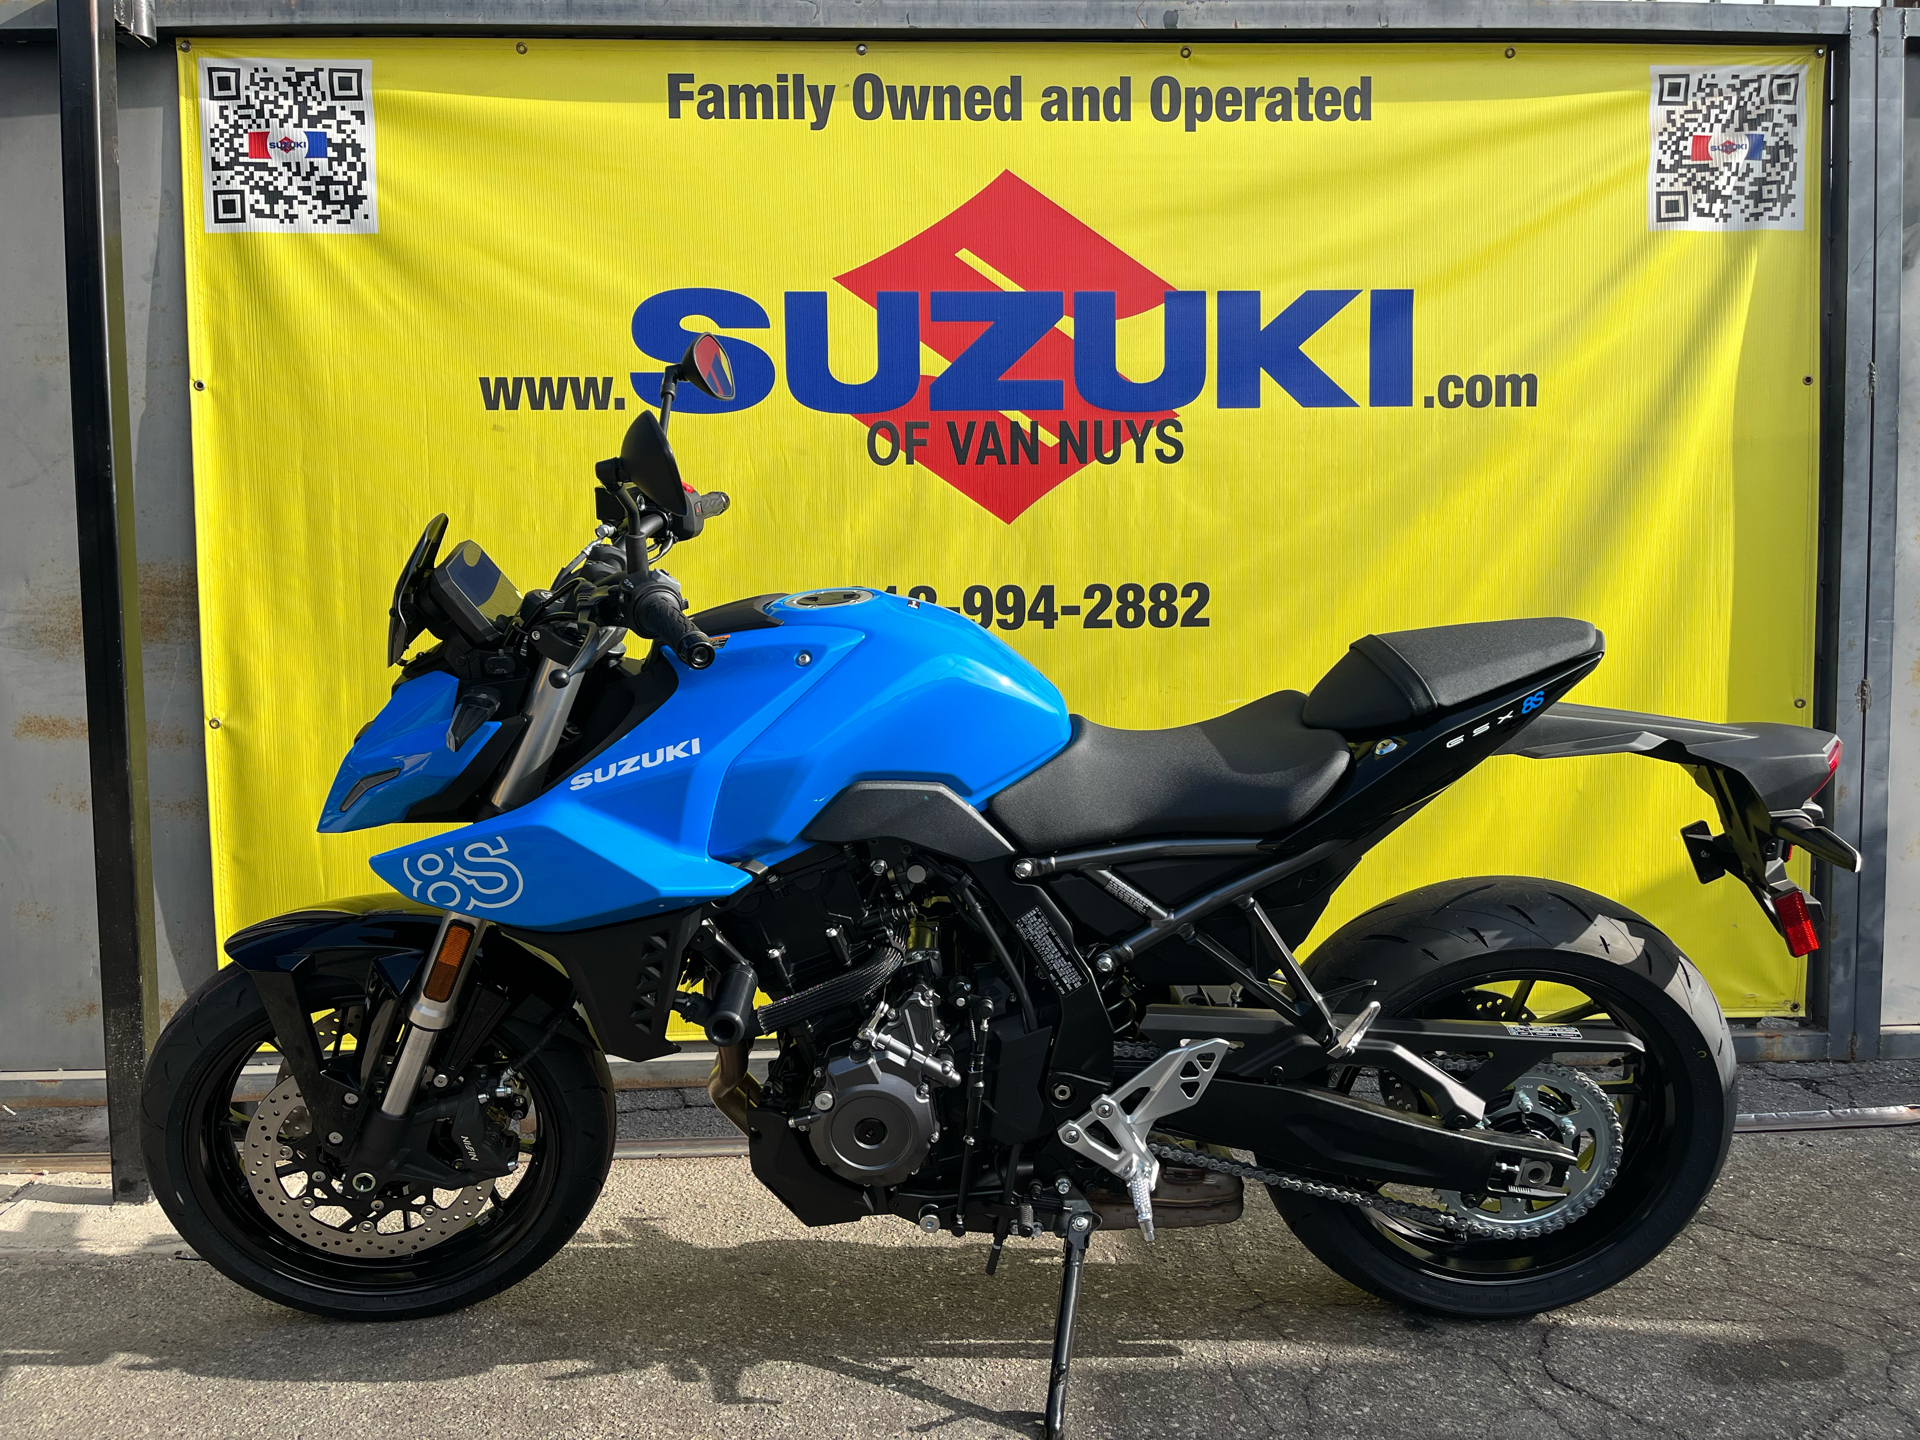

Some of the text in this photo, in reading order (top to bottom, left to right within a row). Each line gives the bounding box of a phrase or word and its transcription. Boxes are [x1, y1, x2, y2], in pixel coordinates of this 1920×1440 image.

[668, 73, 1372, 132] Family Owned and Operated
[269, 141, 306, 149] SUZUKI
[1710, 143, 1747, 152] SUZUKI
[867, 419, 1184, 466] OF VAN NUYS
[570, 737, 701, 791] SUZUKI
